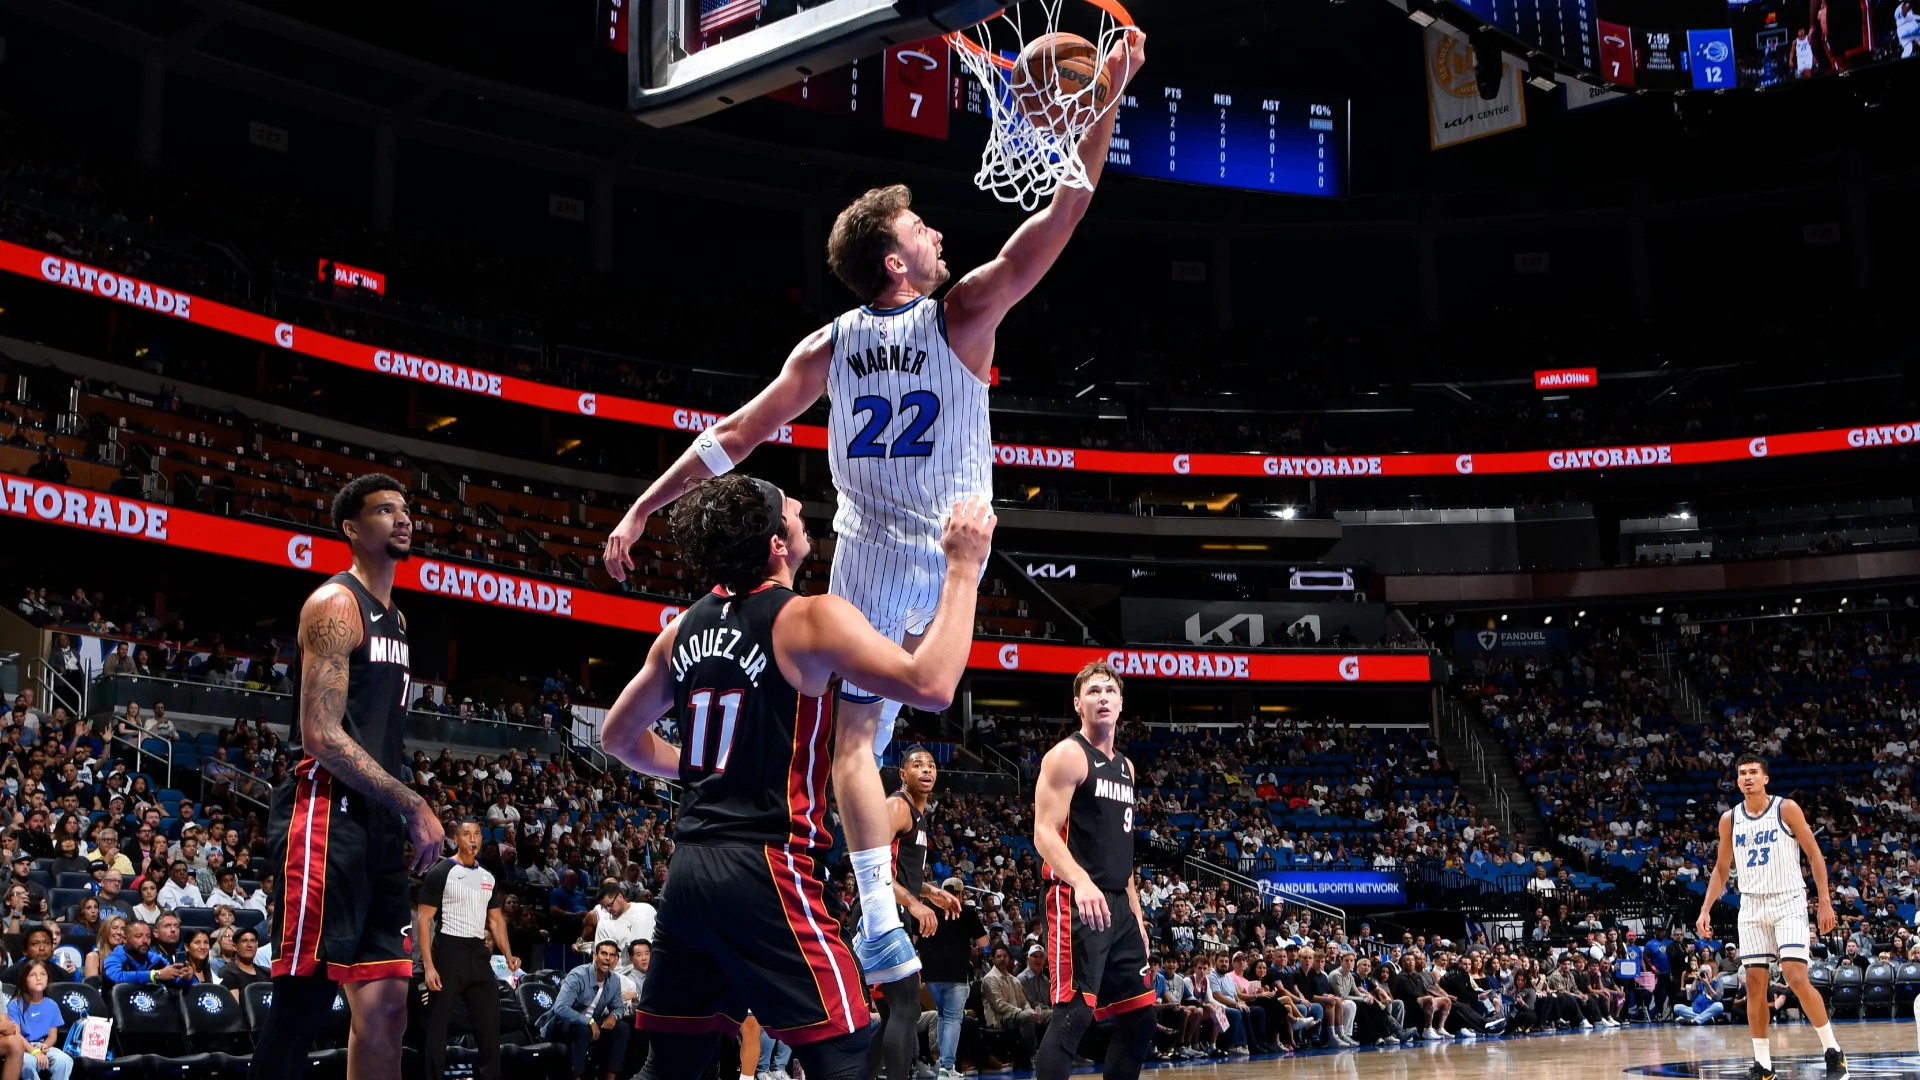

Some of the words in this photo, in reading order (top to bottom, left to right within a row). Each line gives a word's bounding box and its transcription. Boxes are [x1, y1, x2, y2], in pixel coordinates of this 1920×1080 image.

[1646, 33, 1670, 45] 7:55
[1611, 60, 1620, 78] 7
[1705, 66, 1723, 83] 12
[909, 93, 923, 118] 7
[967, 101, 982, 114] CHL
[1165, 87, 1182, 100] PTS
[1214, 94, 1232, 106] REB
[1262, 99, 1280, 112] AST
[1310, 104, 1331, 117] FG%
[1169, 101, 1177, 114] 10
[1220, 108, 1226, 120] 2
[1269, 114, 1275, 126] 0
[1478, 105, 1510, 121] CENTER
[1170, 116, 1176, 128] 2
[1220, 123, 1226, 135] 2
[1269, 128, 1275, 140] 0
[1318, 133, 1324, 145] 0
[1170, 131, 1175, 142] 0
[1220, 137, 1225, 149] 0
[1269, 143, 1275, 155] 0
[1318, 148, 1324, 160] 0
[1109, 151, 1132, 166] SILVA
[1170, 160, 1175, 172] 0
[1220, 166, 1226, 178] 2
[1269, 172, 1275, 184] 2
[1318, 176, 1324, 188] 0
[1170, 145, 1175, 157] 0
[1220, 152, 1225, 164] 0
[1269, 157, 1274, 169] 1
[1318, 162, 1324, 174] 0
[41, 256, 191, 319] GATORADE
[275, 323, 293, 348] G
[374, 351, 502, 397] GATORADE
[847, 345, 927, 380] WAGNER
[578, 393, 596, 416] G
[673, 409, 793, 444] GATE
[846, 390, 941, 459] 22
[698, 434, 713, 452] 22
[1749, 437, 1768, 458] G
[1173, 455, 1190, 475] G
[1263, 457, 1382, 476] GATORADE
[1456, 455, 1473, 474] G
[1549, 446, 1672, 470] GATORADE
[288, 535, 313, 569] G
[420, 562, 572, 615] GATORADE
[307, 618, 355, 645] BEAST
[1501, 631, 1546, 641] FANDUEL
[672, 628, 742, 683] JAQUEZ
[739, 644, 768, 688] JR.
[999, 644, 1019, 670] G
[1107, 652, 1249, 678] GATORADE
[1339, 656, 1360, 681] G
[400, 671, 410, 707] 7
[688, 687, 745, 773] 11
[1095, 778, 1134, 804] MIAMI
[1123, 807, 1133, 833] 9
[1747, 847, 1771, 868] 23
[1273, 882, 1318, 894] FANDUEL
[1318, 882, 1354, 894] SPORTS
[1355, 882, 1399, 894] NETWORK
